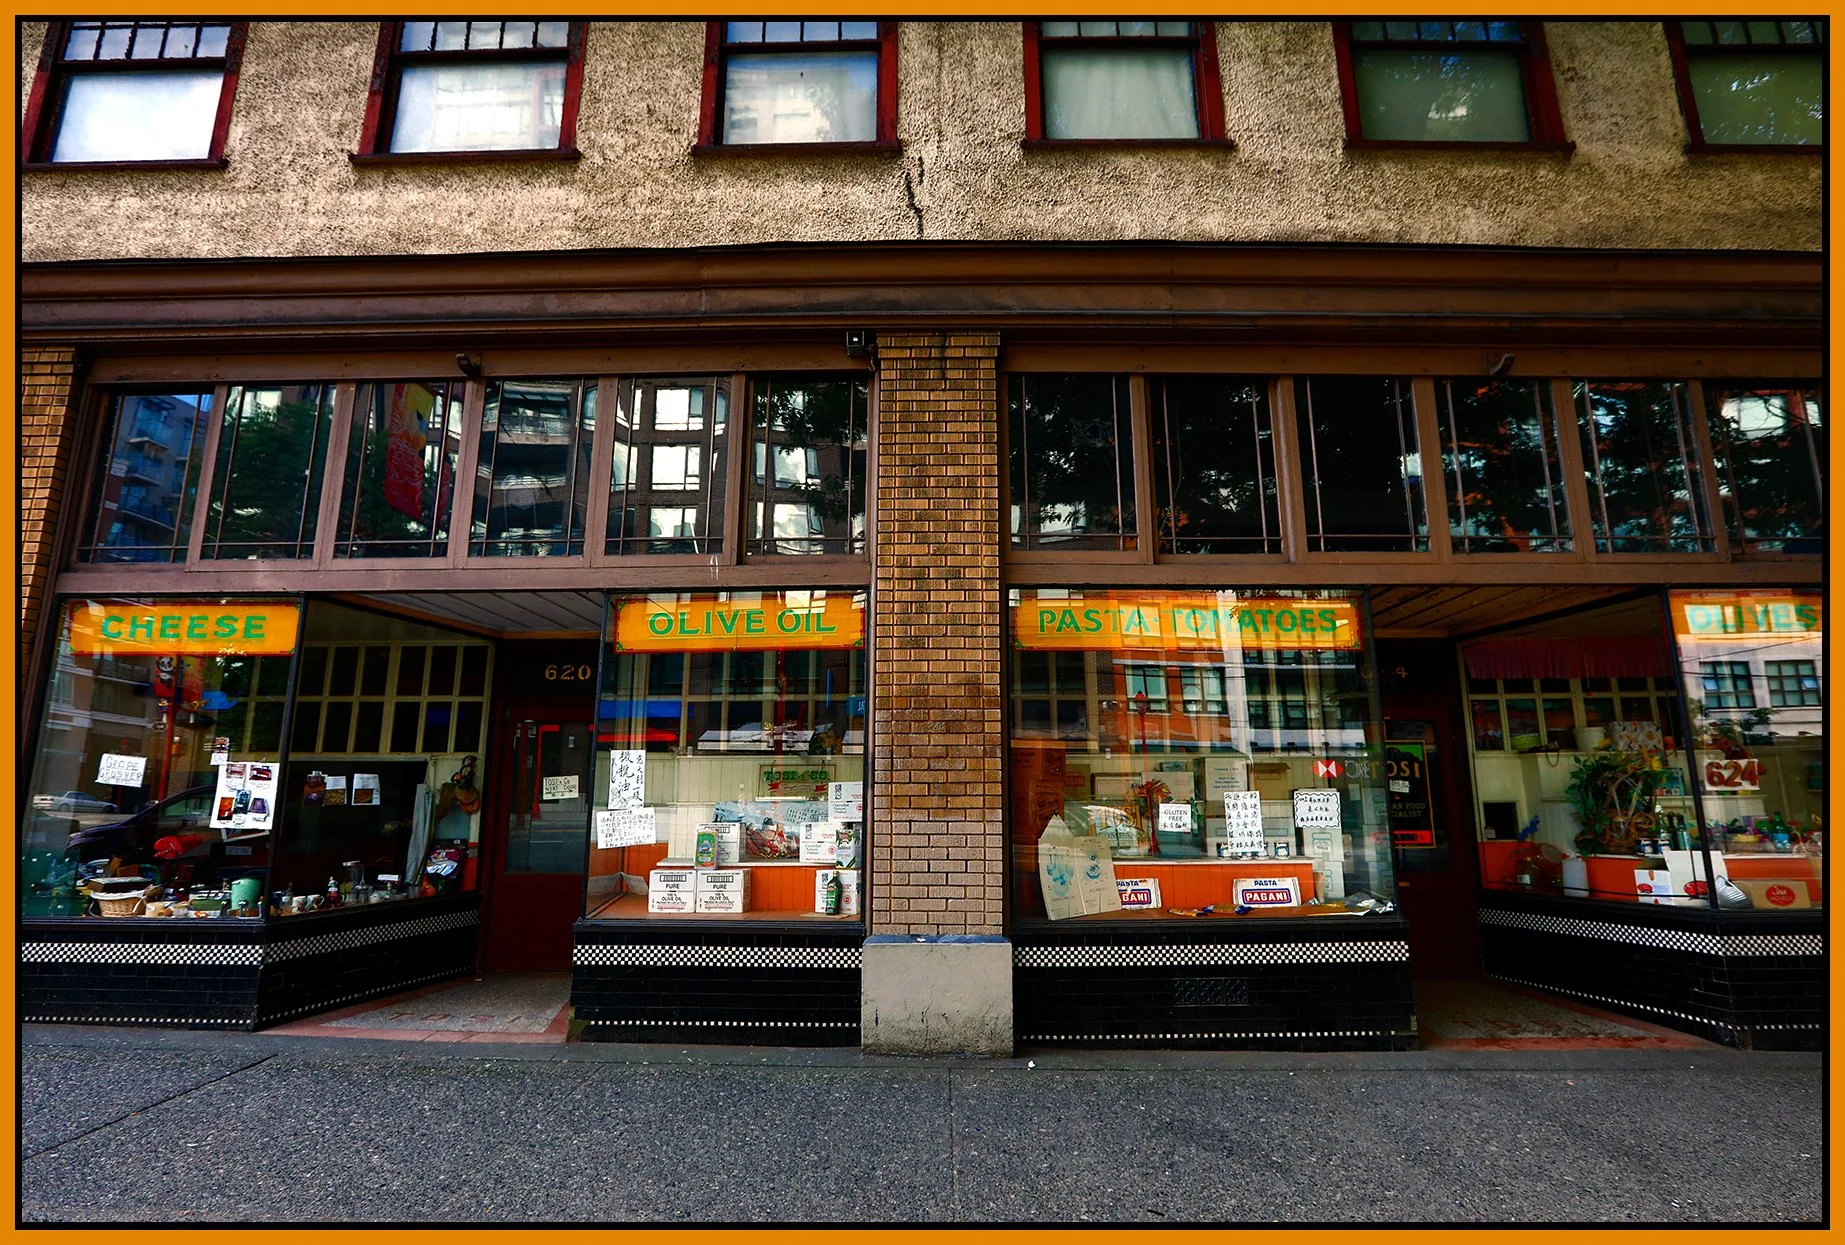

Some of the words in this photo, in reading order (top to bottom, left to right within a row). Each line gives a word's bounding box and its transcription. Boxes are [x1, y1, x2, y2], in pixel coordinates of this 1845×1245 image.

[101, 615, 267, 639] CHEESE
[648, 609, 767, 636] OLIVE
[776, 609, 838, 634] OIL
[1038, 609, 1152, 633] PASTA
[1163, 609, 1339, 633] TOMATOES
[1688, 604, 1818, 631] OLIVES
[545, 664, 592, 681] 620
[763, 770, 797, 781] TOSI
[1705, 760, 1759, 787] 624
[1405, 801, 1426, 810] FOOD
[1246, 892, 1287, 901] PAGANI
